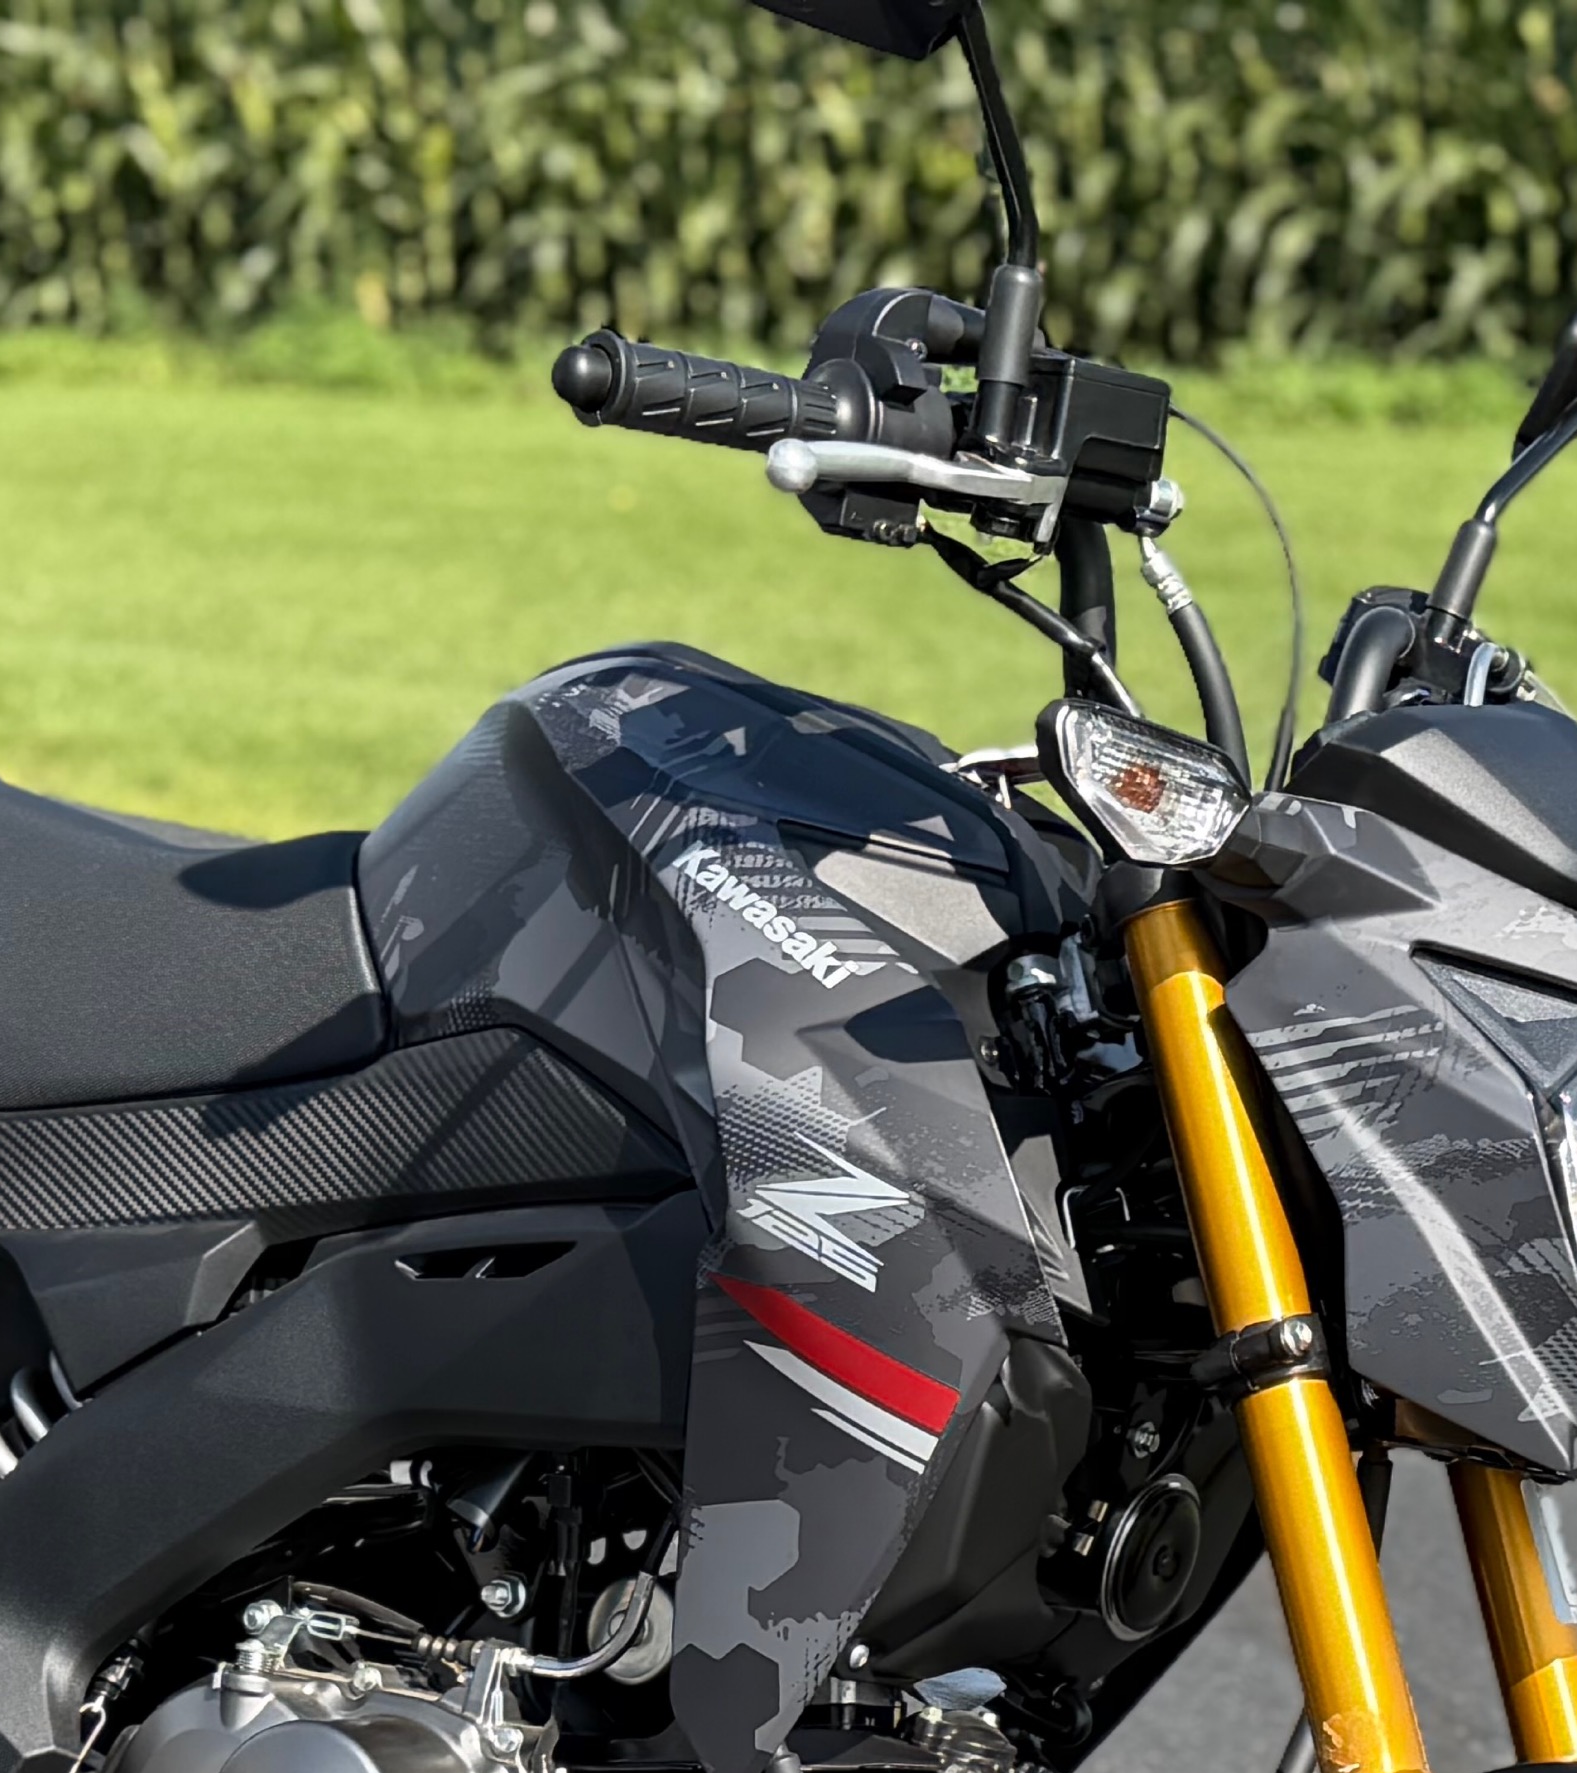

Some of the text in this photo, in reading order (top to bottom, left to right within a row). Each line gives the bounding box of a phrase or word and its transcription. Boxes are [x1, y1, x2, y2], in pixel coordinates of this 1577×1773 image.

[674, 841, 862, 990] Kawasaki
[736, 1197, 886, 1293] 125
[755, 1131, 912, 1268] Z
